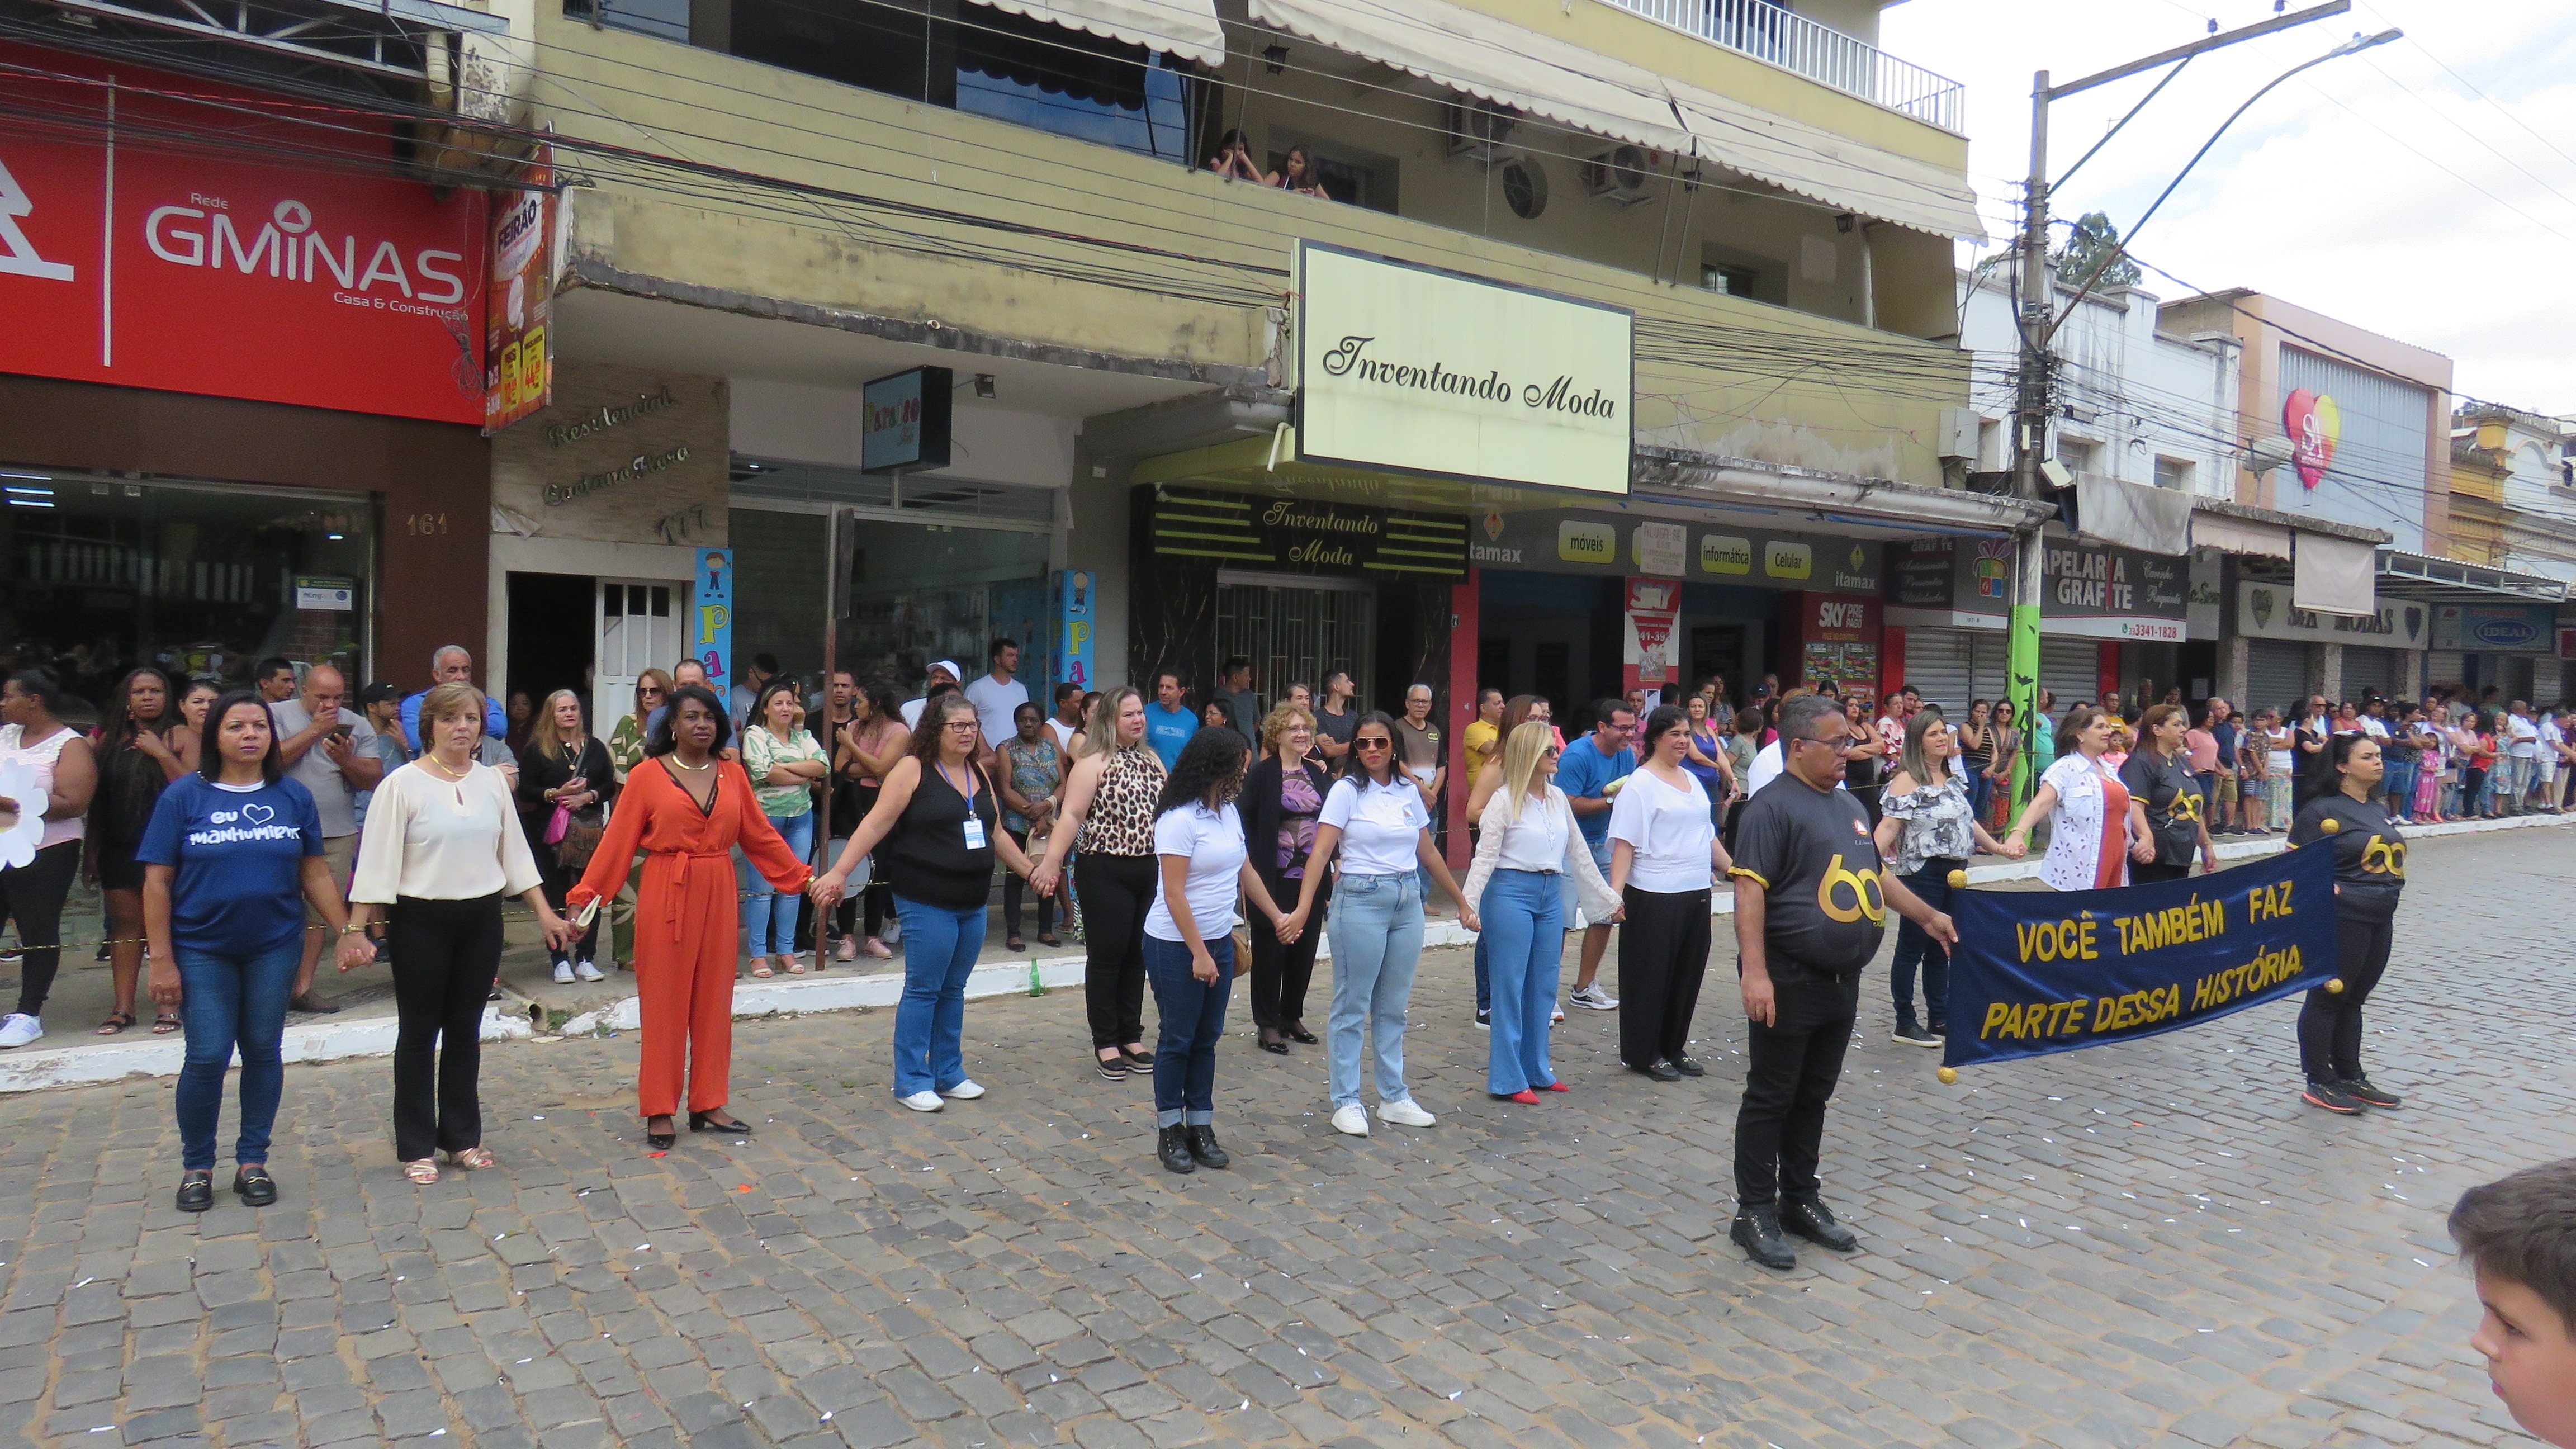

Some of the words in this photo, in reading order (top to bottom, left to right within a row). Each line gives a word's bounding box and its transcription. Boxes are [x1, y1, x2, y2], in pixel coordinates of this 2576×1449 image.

[190, 192, 229, 209] Rede
[498, 199, 537, 254] FEIRÃO
[334, 292, 370, 307] Casa
[374, 298, 386, 309] &
[389, 300, 468, 321] Construção
[1322, 335, 1512, 402] Inventando
[1523, 375, 1614, 419] Moda
[547, 385, 674, 447] Residencial
[407, 513, 447, 536] 161
[1263, 501, 1378, 534] Inventando
[1289, 539, 1352, 565] Moda
[1470, 541, 1522, 564] tamax
[1570, 533, 1603, 552] móveis
[1703, 545, 1749, 565] informática
[1775, 552, 1802, 569] Celular
[1835, 571, 1874, 590] itamax
[1818, 602, 1847, 627] SKY
[2483, 626, 2530, 637] IDEAL
[210, 811, 238, 825] eu
[1817, 853, 1886, 922] 60
[2016, 911, 2098, 963] VOCÊ
[2113, 893, 2225, 955] TAMBÉM
[2248, 880, 2293, 924] FAZ
[1980, 998, 2089, 1040] PARTE
[2091, 983, 2180, 1033] DESSA
[2191, 944, 2303, 1012] HISTÓRIA.
